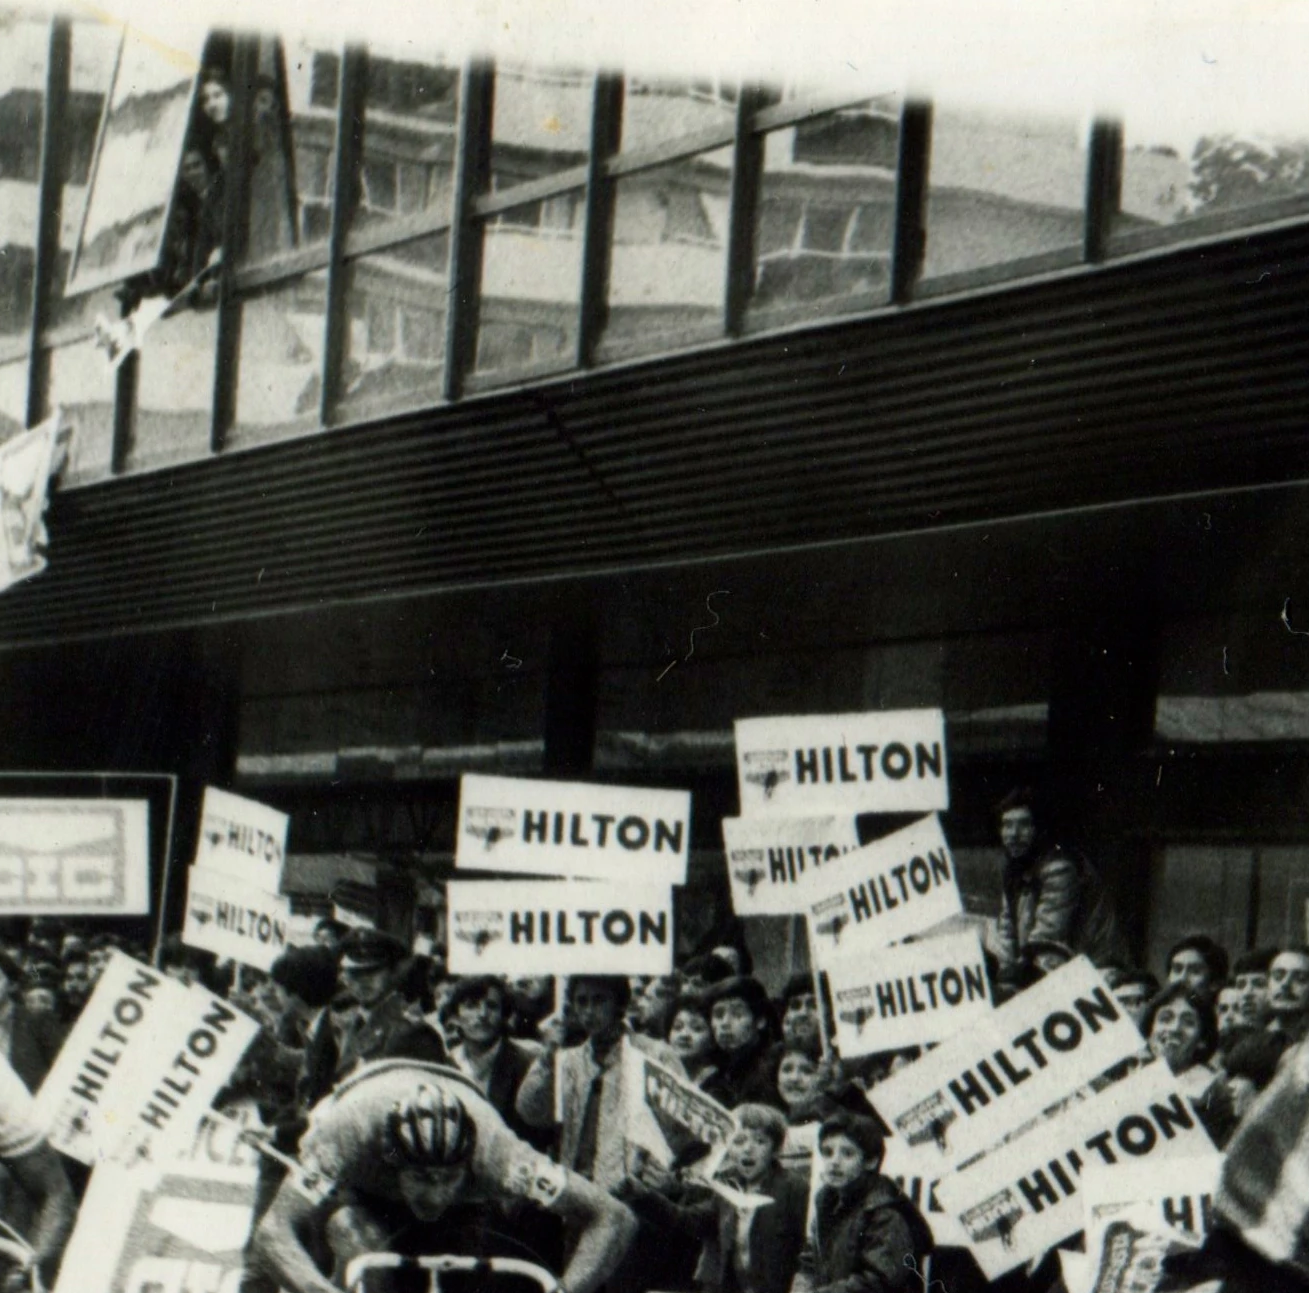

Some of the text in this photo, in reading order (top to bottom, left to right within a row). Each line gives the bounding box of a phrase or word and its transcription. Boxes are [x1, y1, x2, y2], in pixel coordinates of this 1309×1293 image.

[795, 741, 941, 784] HILTON
[522, 809, 683, 854] HILTON
[849, 847, 951, 923] HILTON
[216, 901, 286, 946] HILTON
[510, 909, 667, 945] HILTON
[876, 963, 986, 1019] HILTON
[70, 968, 161, 1104] HILTON
[948, 986, 1120, 1116] HILTON
[139, 1000, 237, 1130] HILTON
